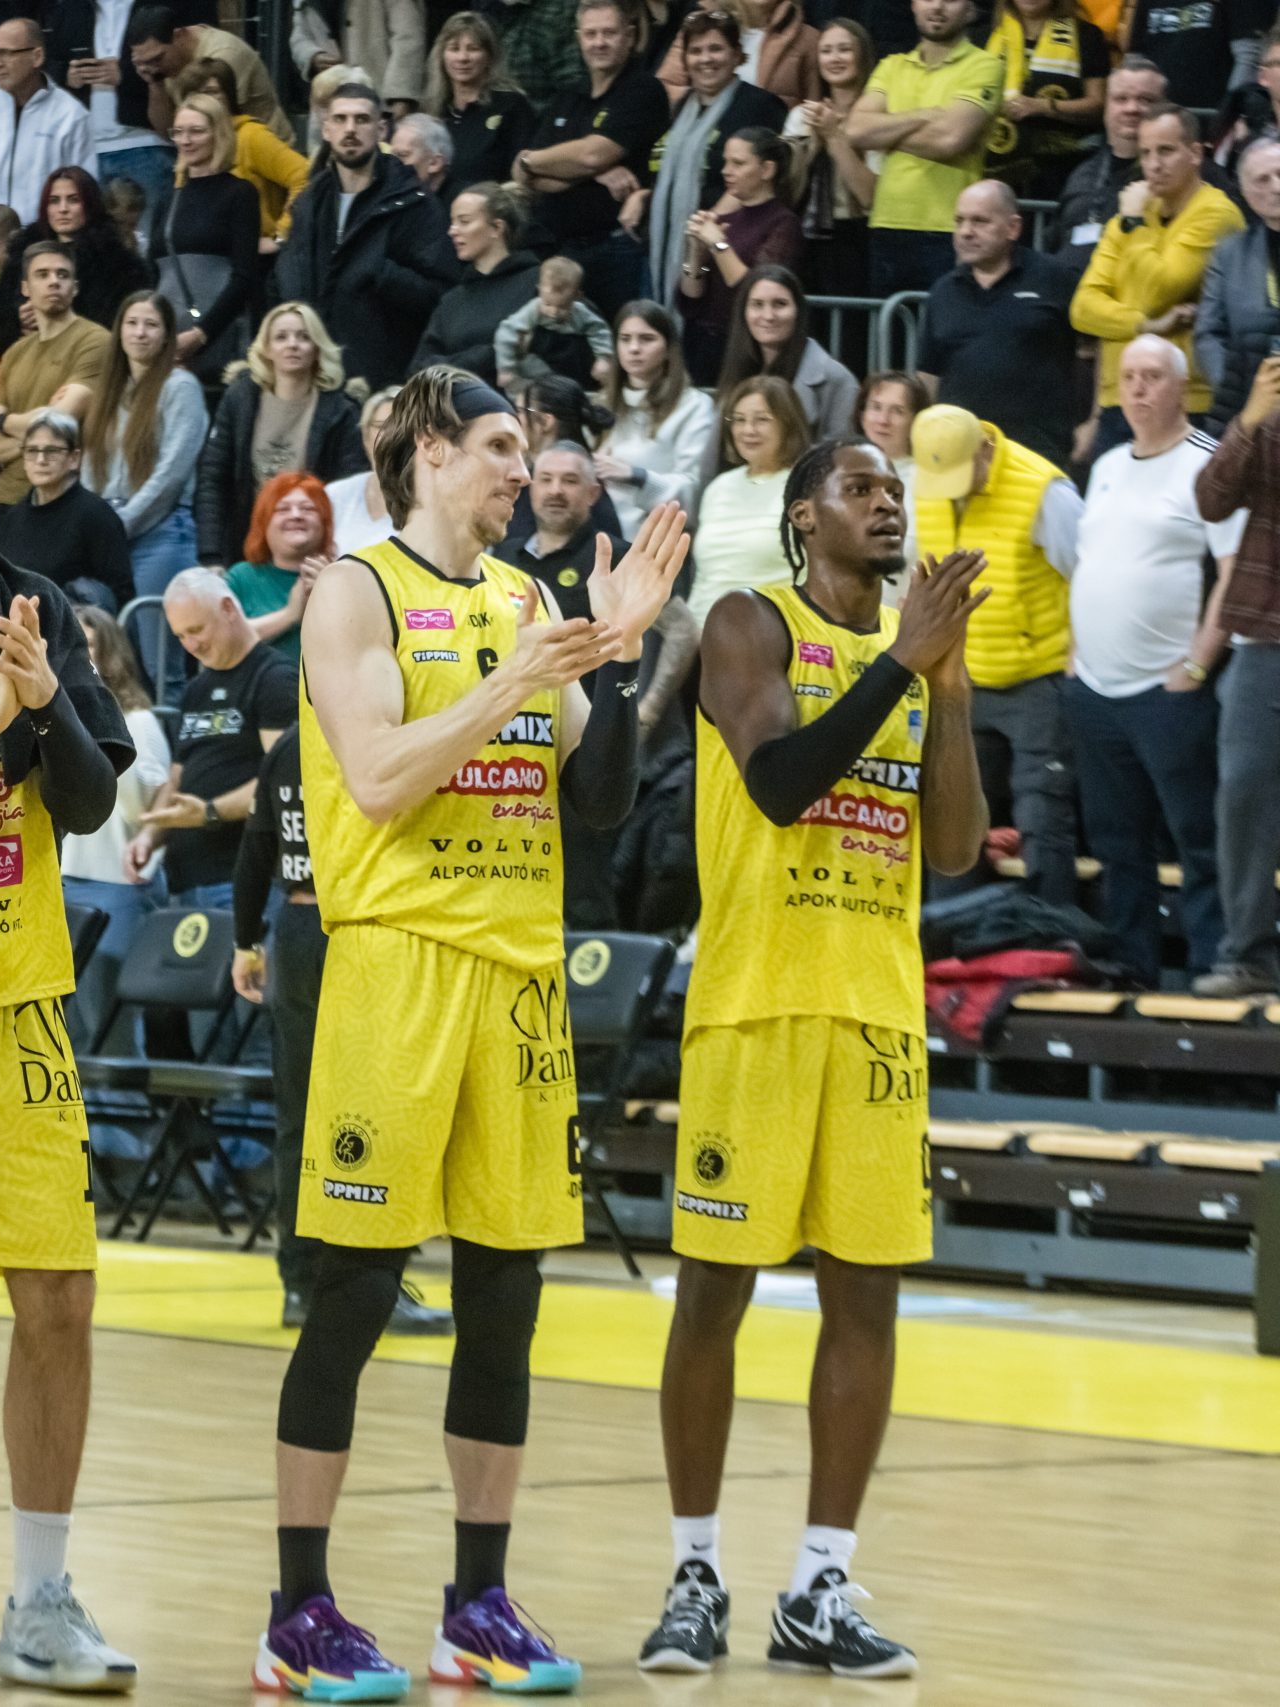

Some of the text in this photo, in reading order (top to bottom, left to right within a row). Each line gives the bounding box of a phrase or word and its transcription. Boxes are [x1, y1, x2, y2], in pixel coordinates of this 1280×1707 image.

[456, 767, 543, 791] ULCANO
[429, 838, 552, 856] VOLVO
[429, 863, 552, 884] ALPOK AUTÓ KFT.
